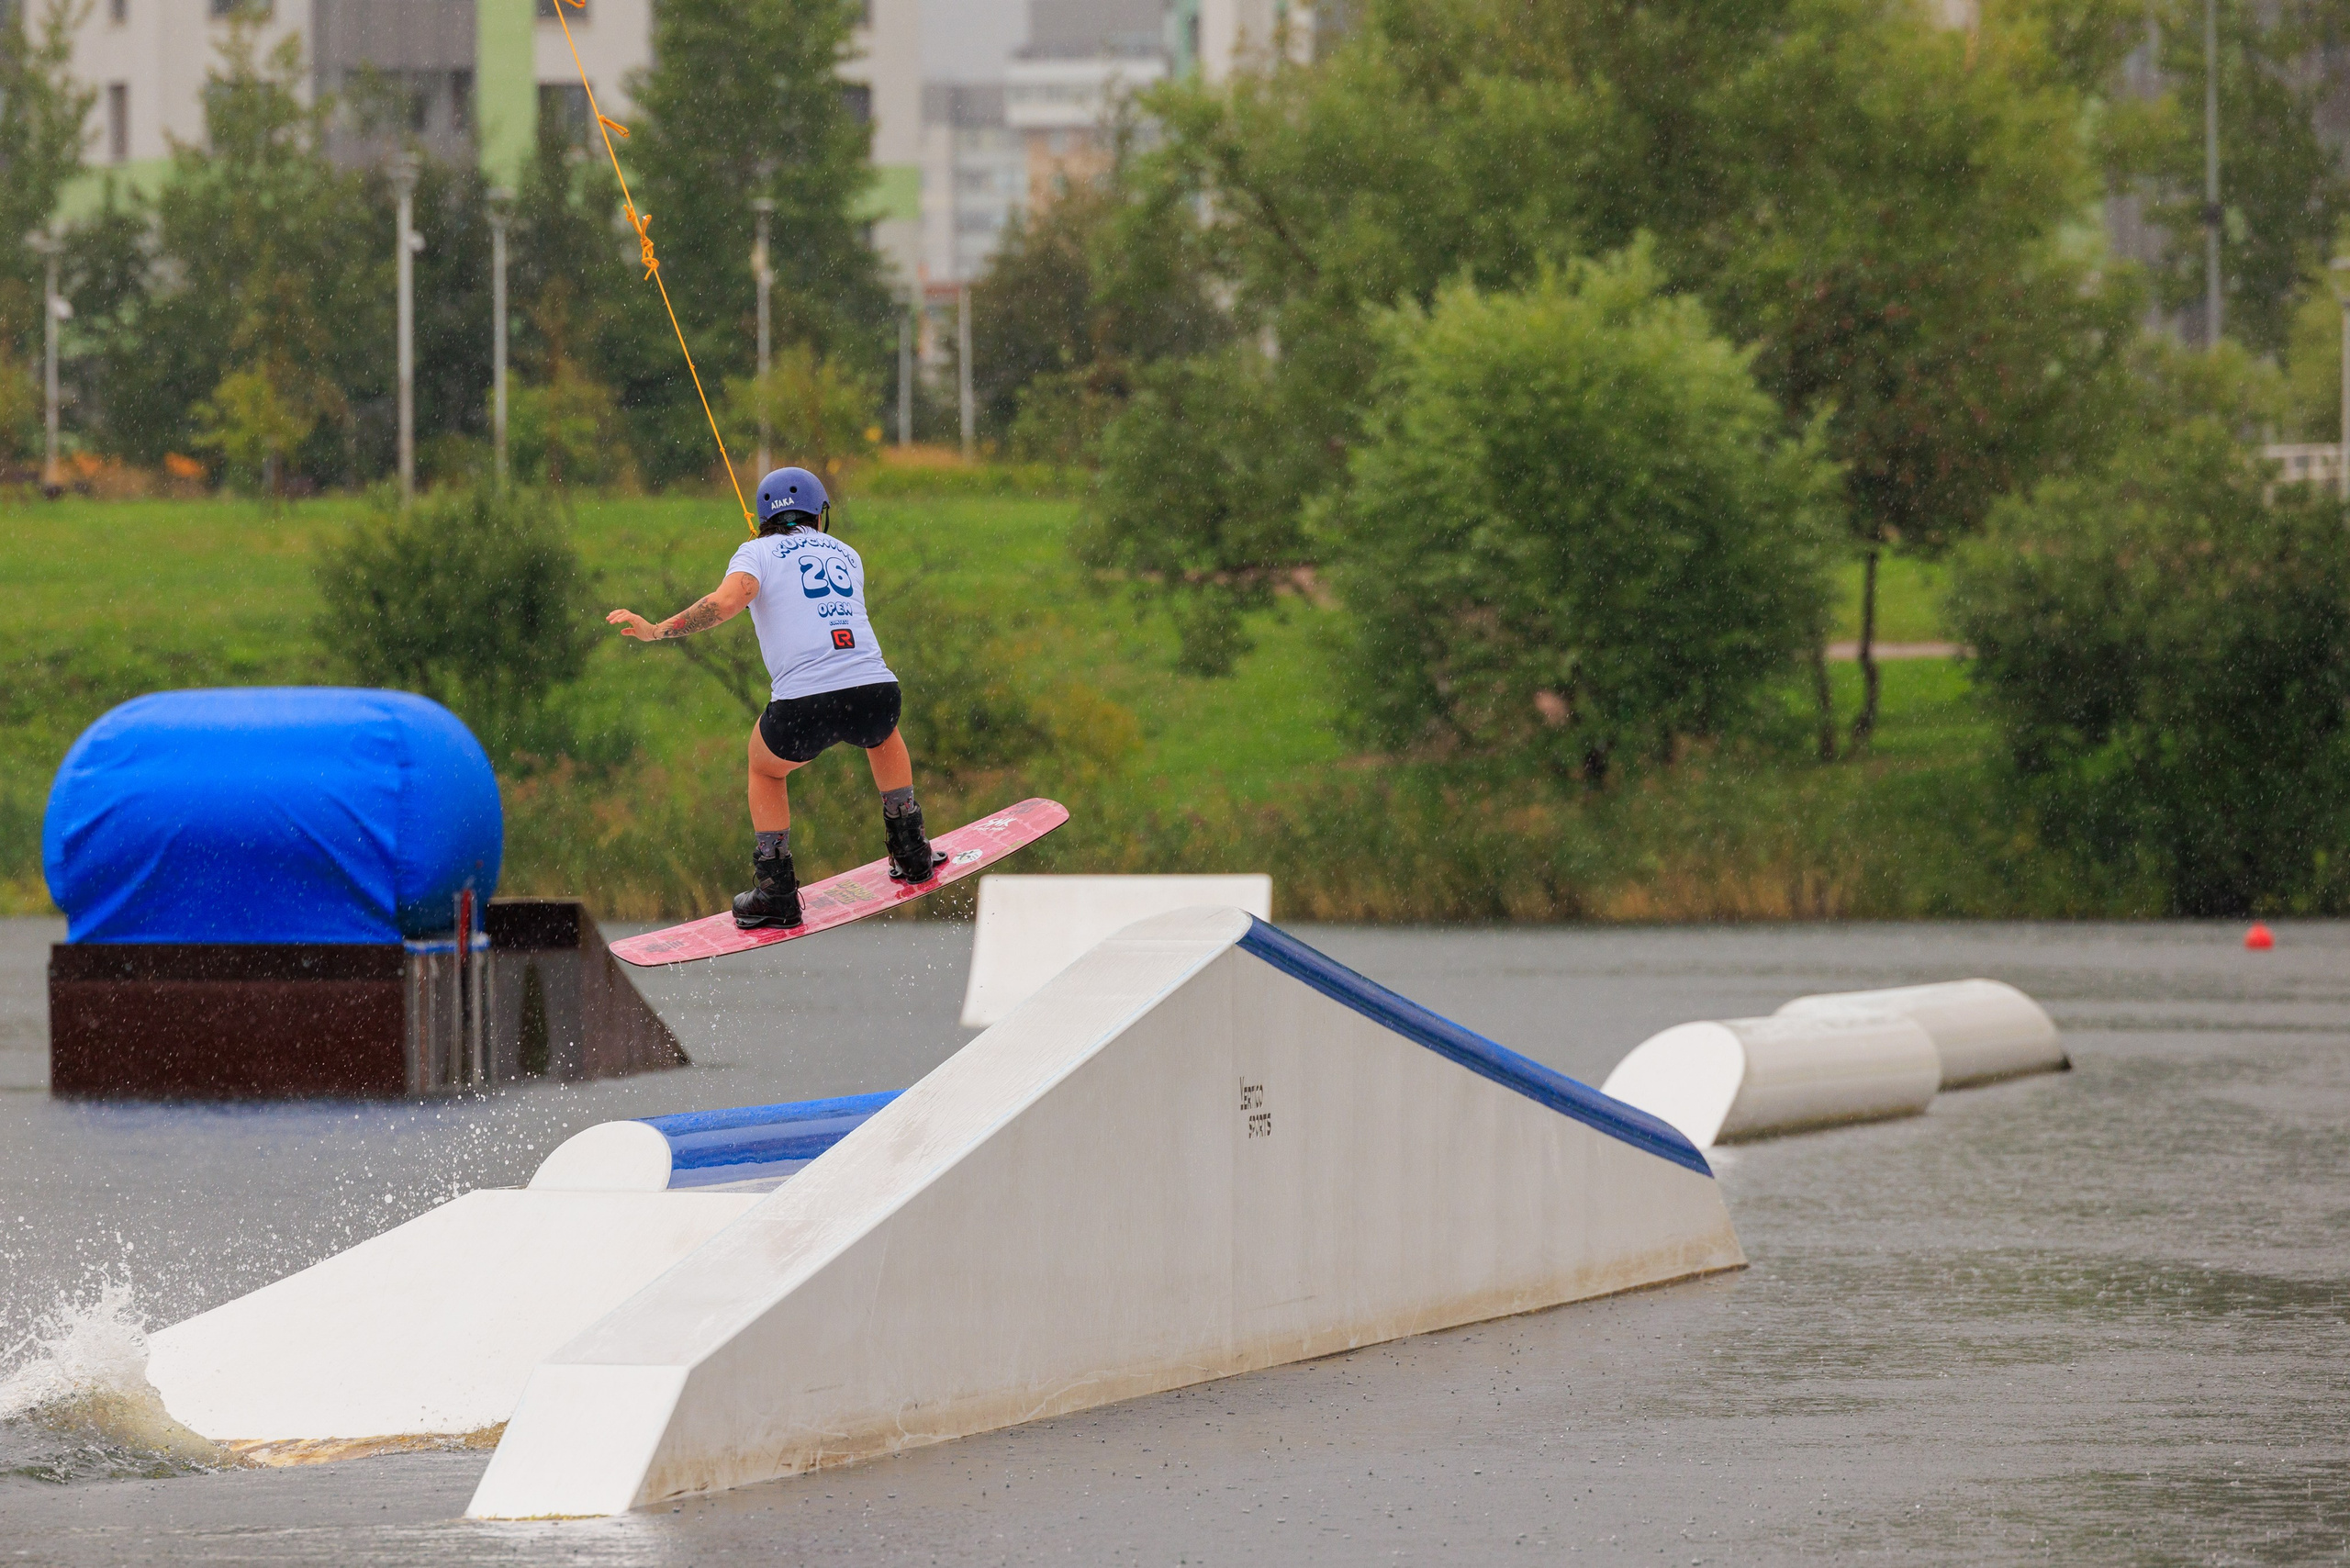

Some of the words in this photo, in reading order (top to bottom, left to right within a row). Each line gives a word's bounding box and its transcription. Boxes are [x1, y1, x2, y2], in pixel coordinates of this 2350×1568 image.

[771, 497, 795, 510] ATAKA
[798, 554, 854, 599] 26
[817, 601, 853, 618] OPEN
[1248, 1113, 1271, 1138] SPORTS
